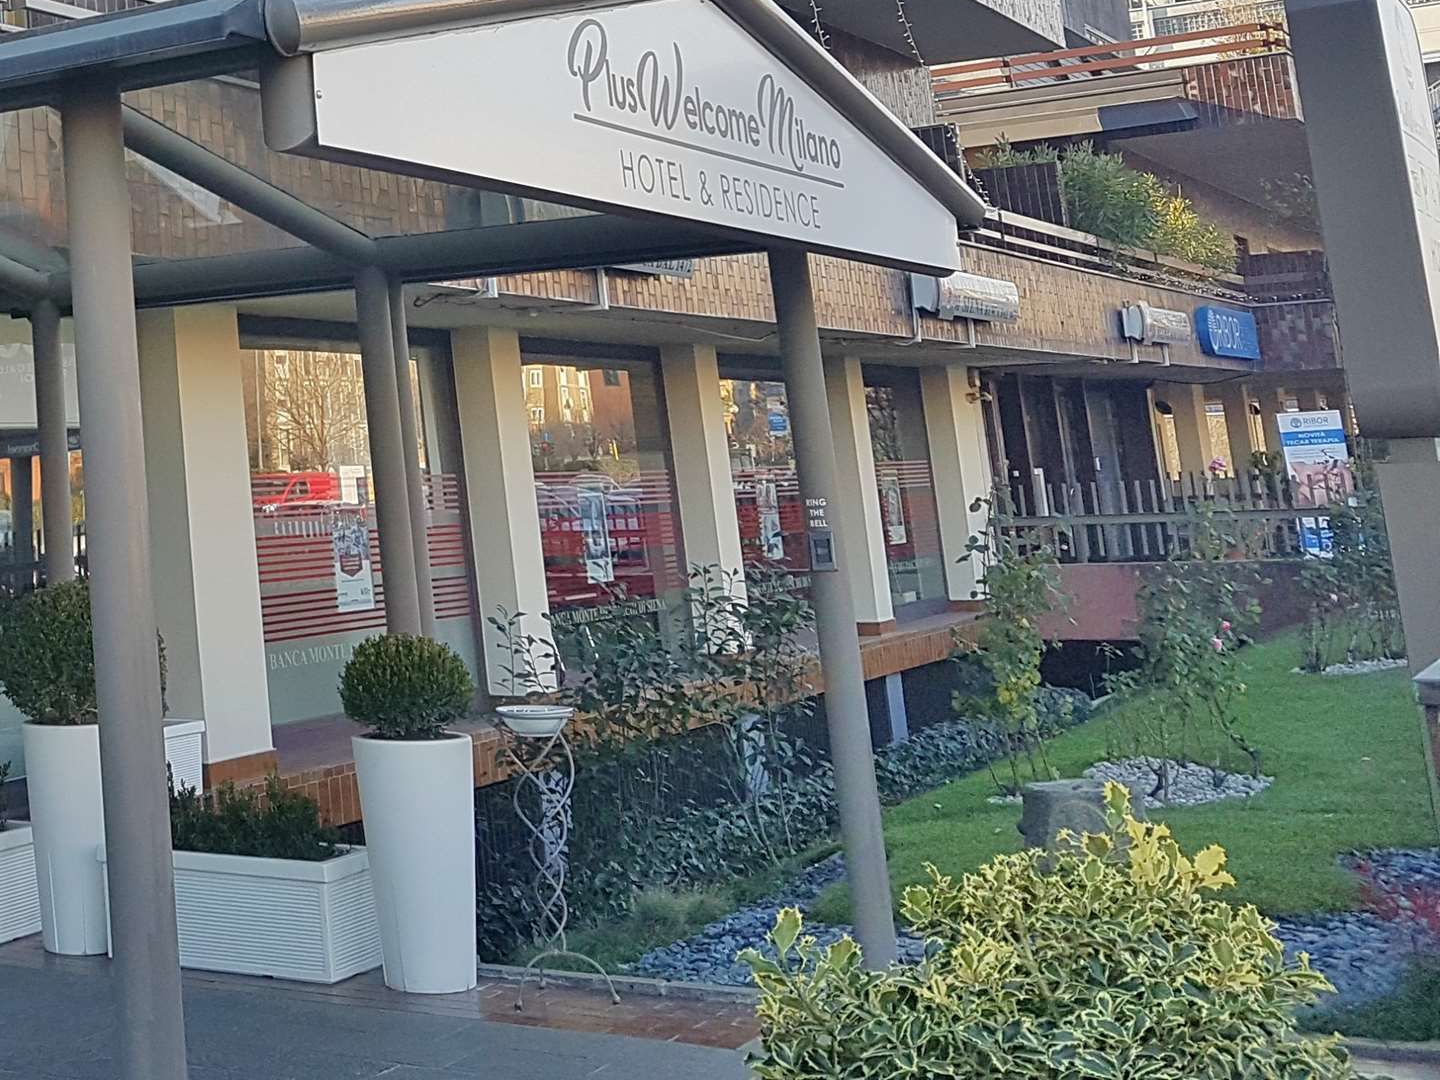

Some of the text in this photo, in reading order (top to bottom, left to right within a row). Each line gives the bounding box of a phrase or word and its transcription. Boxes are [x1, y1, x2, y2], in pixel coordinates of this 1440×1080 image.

[620, 149, 822, 229] HOTEL & RESIDENCE
[809, 509, 825, 517] THE
[269, 649, 308, 670] BANCA
